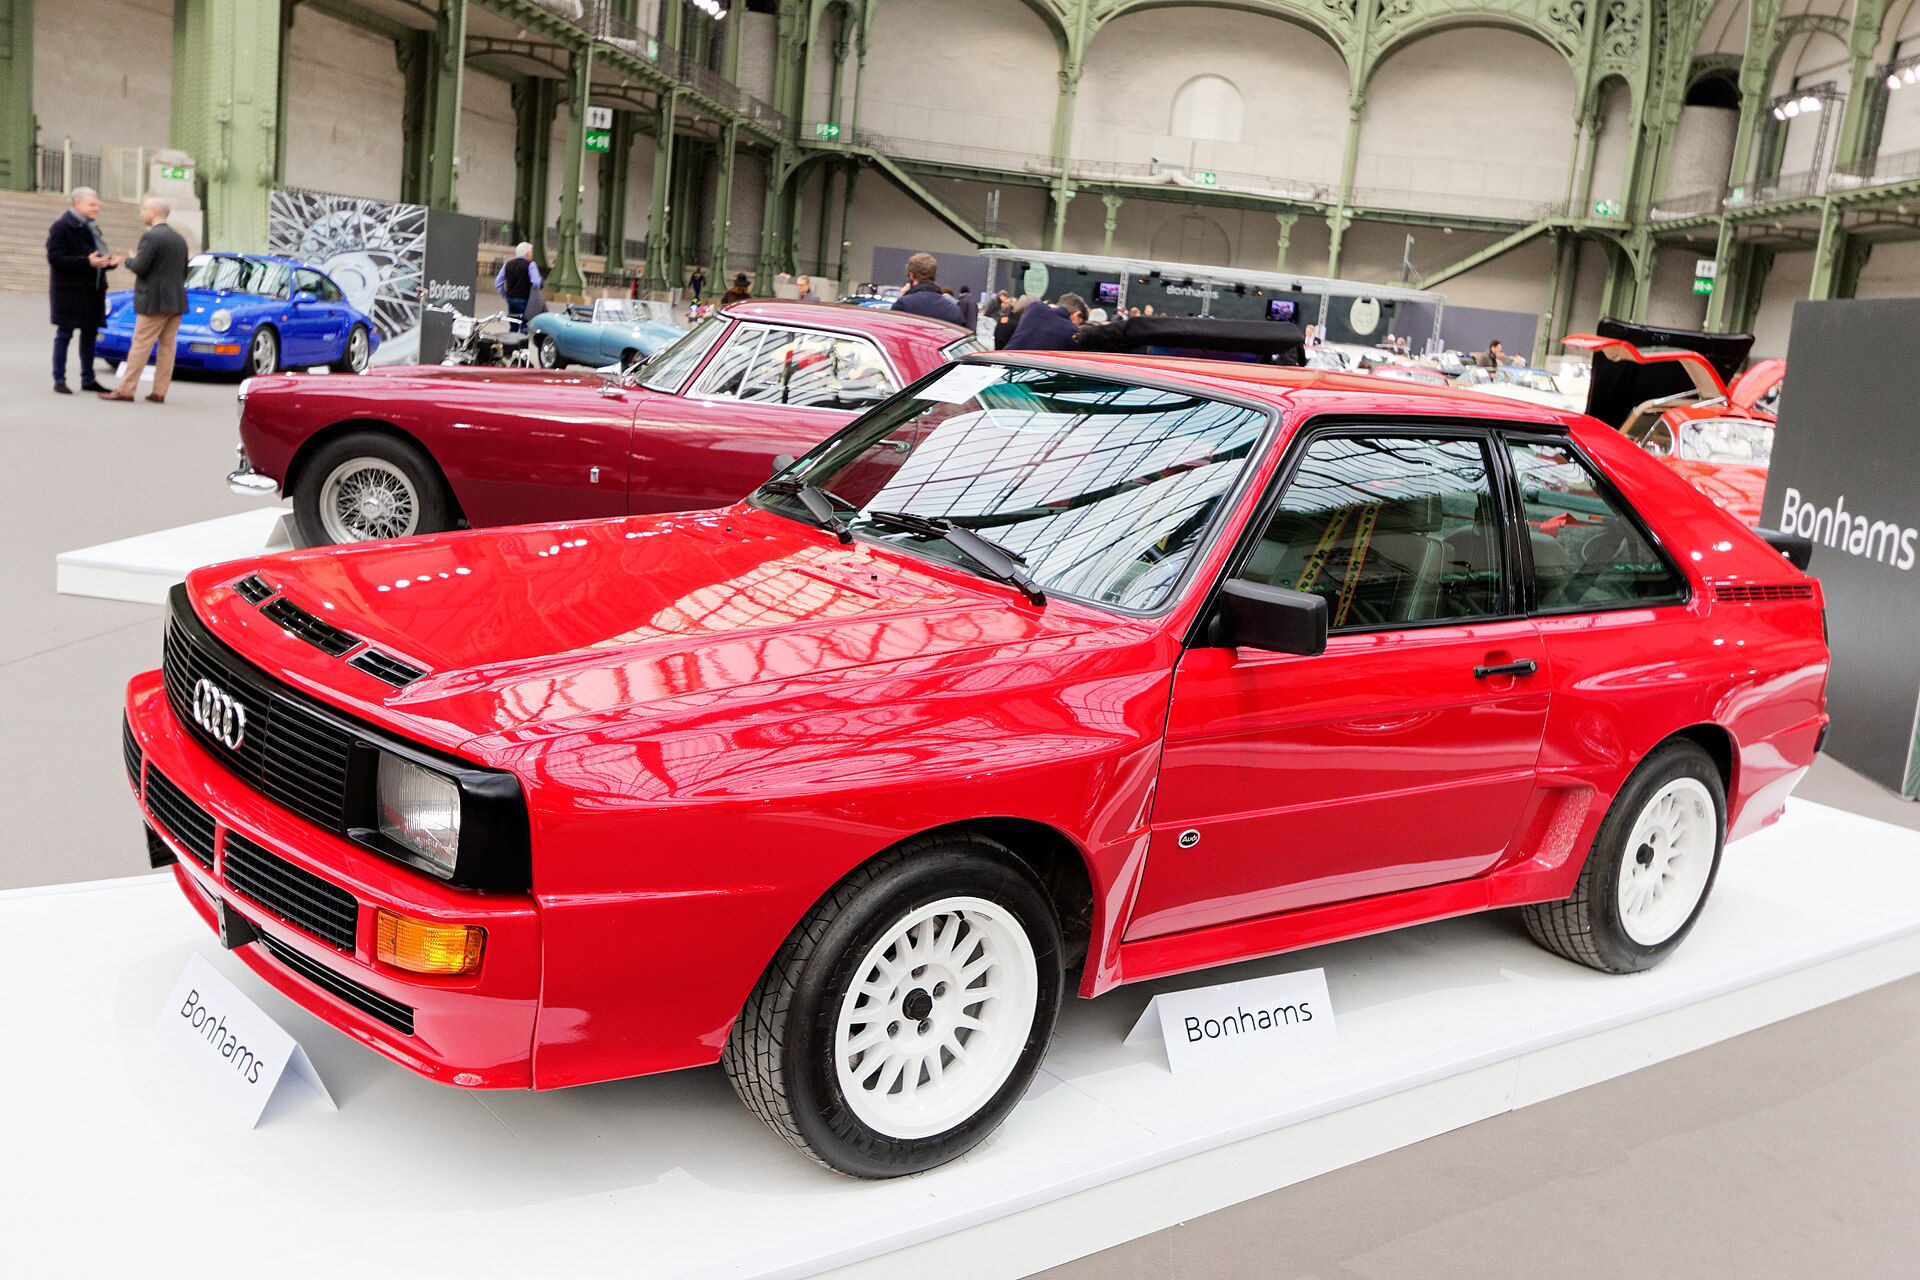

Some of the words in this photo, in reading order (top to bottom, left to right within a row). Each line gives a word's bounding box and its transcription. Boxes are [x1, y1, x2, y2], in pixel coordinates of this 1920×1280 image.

[429, 279, 470, 301] Bonhams
[1166, 284, 1219, 300] Bonhams
[1780, 487, 1919, 571] Bonhams
[1181, 834, 1199, 844] Audi
[180, 988, 264, 1084] Bonhams
[1184, 1002, 1313, 1043] Bonhams
